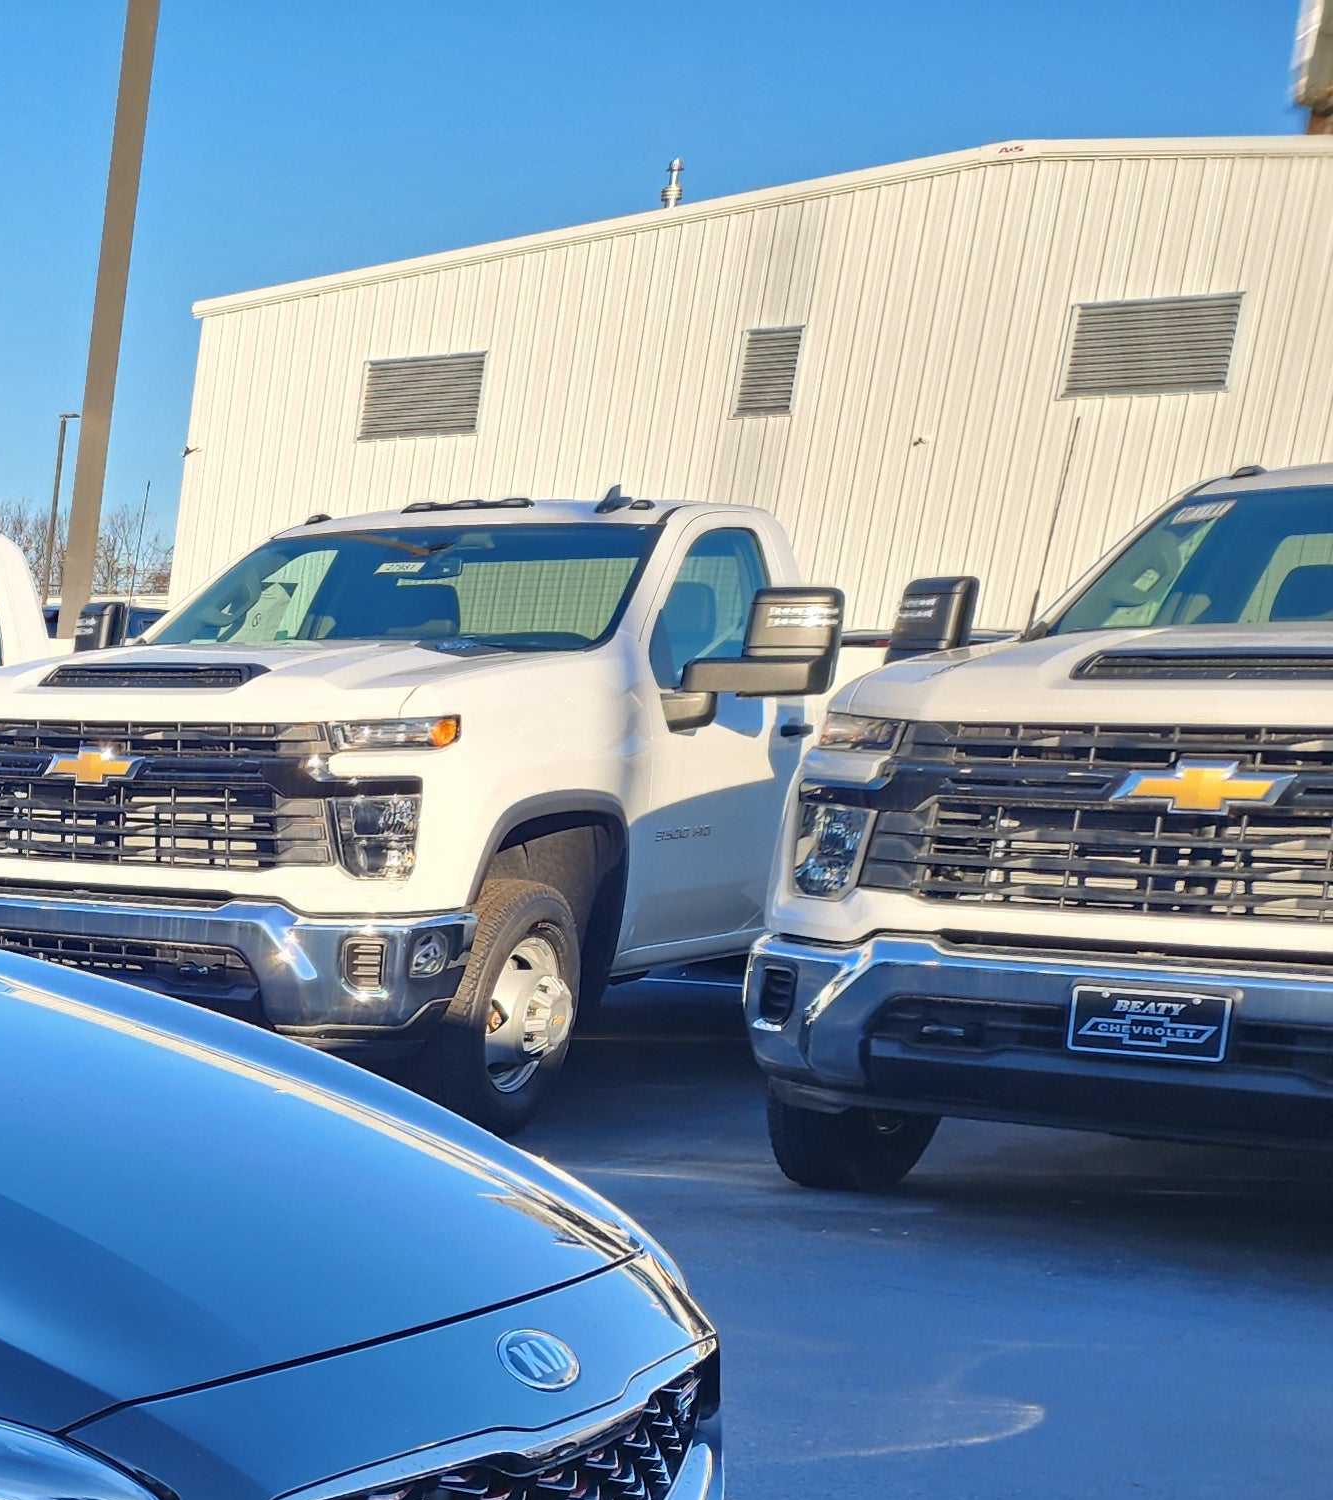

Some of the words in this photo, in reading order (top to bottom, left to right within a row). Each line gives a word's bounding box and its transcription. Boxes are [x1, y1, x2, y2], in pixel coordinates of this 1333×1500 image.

[1113, 999, 1187, 1016] BEATY
[1097, 1022, 1198, 1039] CHEVROLET
[509, 1337, 572, 1378] KIA
